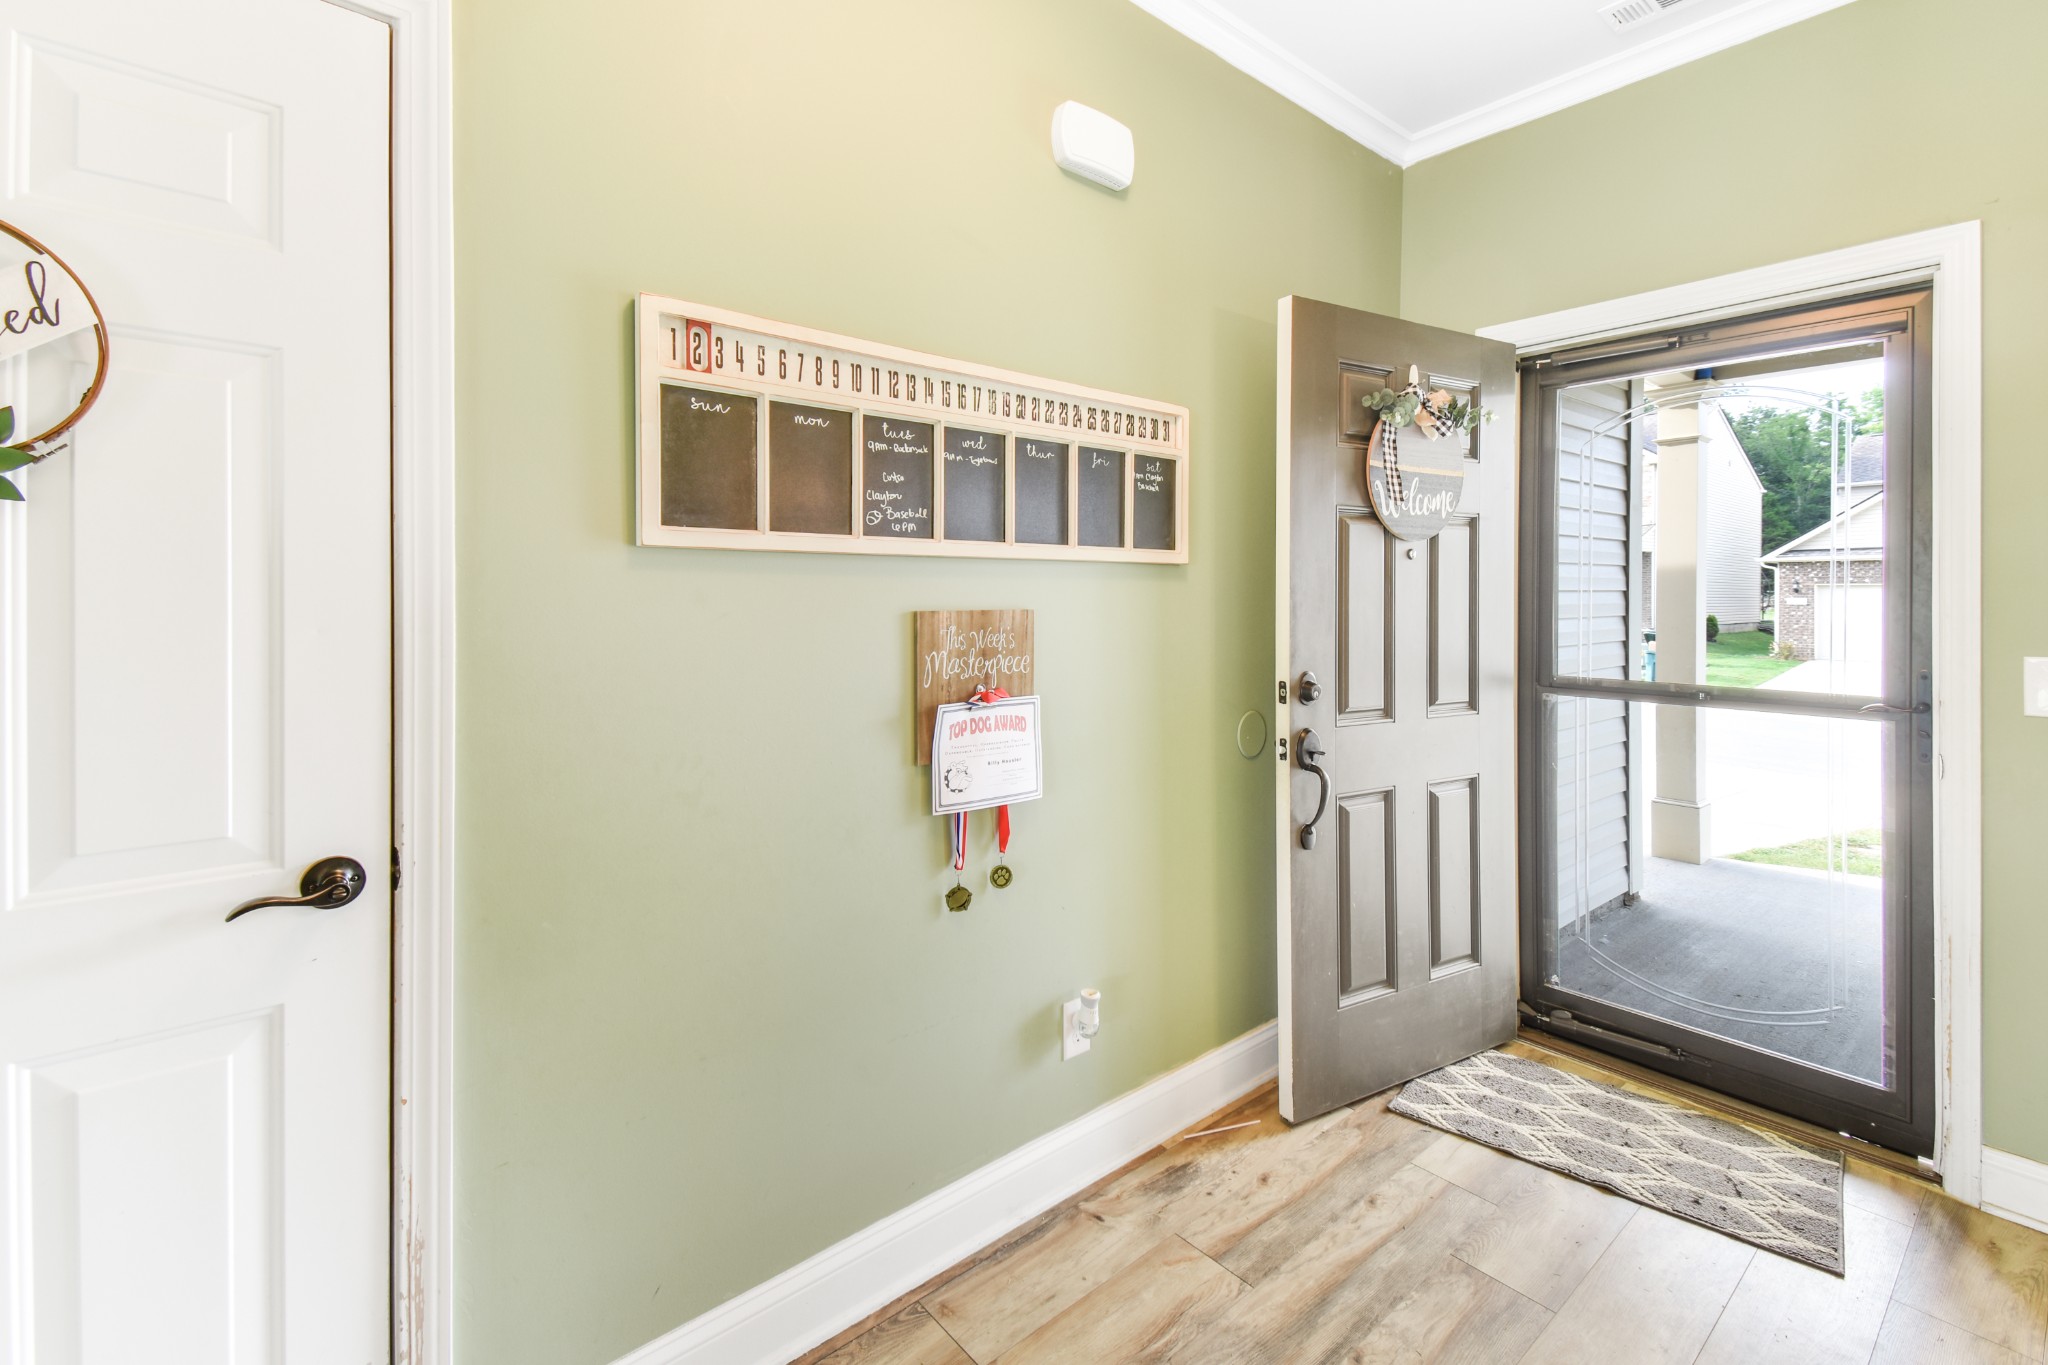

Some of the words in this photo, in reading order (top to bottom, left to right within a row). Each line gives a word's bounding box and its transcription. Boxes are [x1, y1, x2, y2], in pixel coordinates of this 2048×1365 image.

[0, 260, 60, 335] ed
[671, 327, 676, 361] 1
[693, 332, 702, 365] 2
[715, 336, 723, 369] 3
[736, 340, 744, 373] 4
[757, 345, 765, 376] 5
[779, 349, 786, 380] 6
[798, 353, 804, 382] 7
[815, 356, 822, 386] 8
[832, 359, 839, 389] 9
[850, 363, 862, 393] 10
[871, 367, 880, 396] 11
[888, 370, 899, 399] 12
[906, 374, 916, 402] 13
[924, 377, 934, 405] 14
[941, 380, 951, 408] 15
[957, 383, 967, 410] 16
[973, 386, 981, 412] 17
[987, 389, 997, 416] 18
[1002, 391, 1011, 418] 19
[1016, 394, 1026, 420] 20
[1031, 397, 1041, 422] 21
[1045, 399, 1055, 424] 22
[1059, 402, 1069, 427] 23
[1073, 404, 1082, 429] 24
[1087, 407, 1097, 431] 25
[1101, 409, 1110, 433] 26
[1114, 411, 1122, 435] 27
[1126, 414, 1135, 437] 28
[1138, 416, 1147, 439] 29
[1150, 418, 1159, 441] 30
[1163, 420, 1170, 442] 31
[690, 397, 731, 414] sun
[794, 415, 830, 427] mon
[882, 422, 915, 440] tues
[961, 435, 987, 450] wed
[1026, 443, 1055, 459] thur
[1092, 452, 1110, 469] fri
[1145, 461, 1163, 473] sat
[866, 489, 903, 508] Clayton
[1374, 476, 1456, 519] Welcome
[883, 506, 928, 520] Baseball
[940, 625, 967, 655] This
[969, 626, 1016, 652] Week's
[923, 647, 1030, 689] Masterpiece
[949, 719, 968, 741] TOP
[969, 715, 992, 735] DOG
[993, 714, 1027, 733] AWARD
